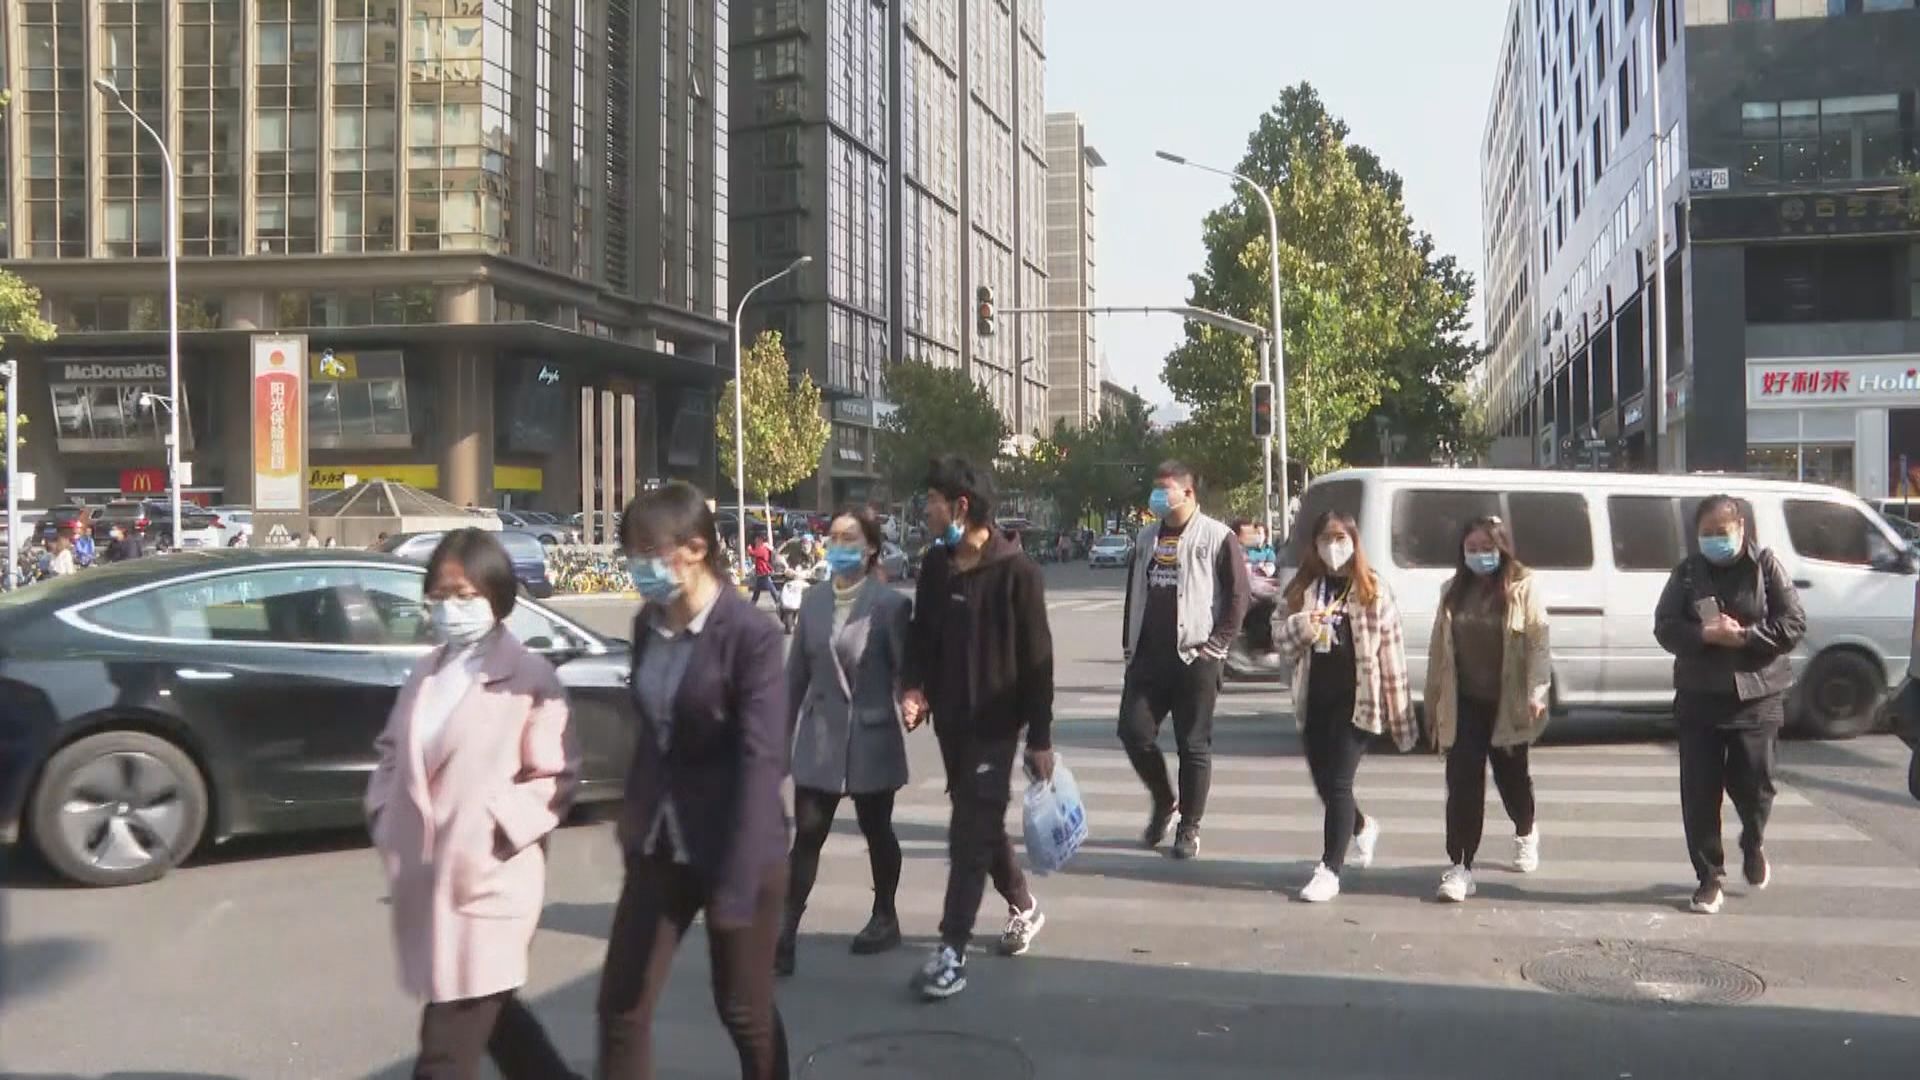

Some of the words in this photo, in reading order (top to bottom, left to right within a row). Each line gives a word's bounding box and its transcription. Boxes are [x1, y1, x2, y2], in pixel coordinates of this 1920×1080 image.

[64, 364, 167, 380] McDonald's
[1761, 370, 1850, 394] 好利来
